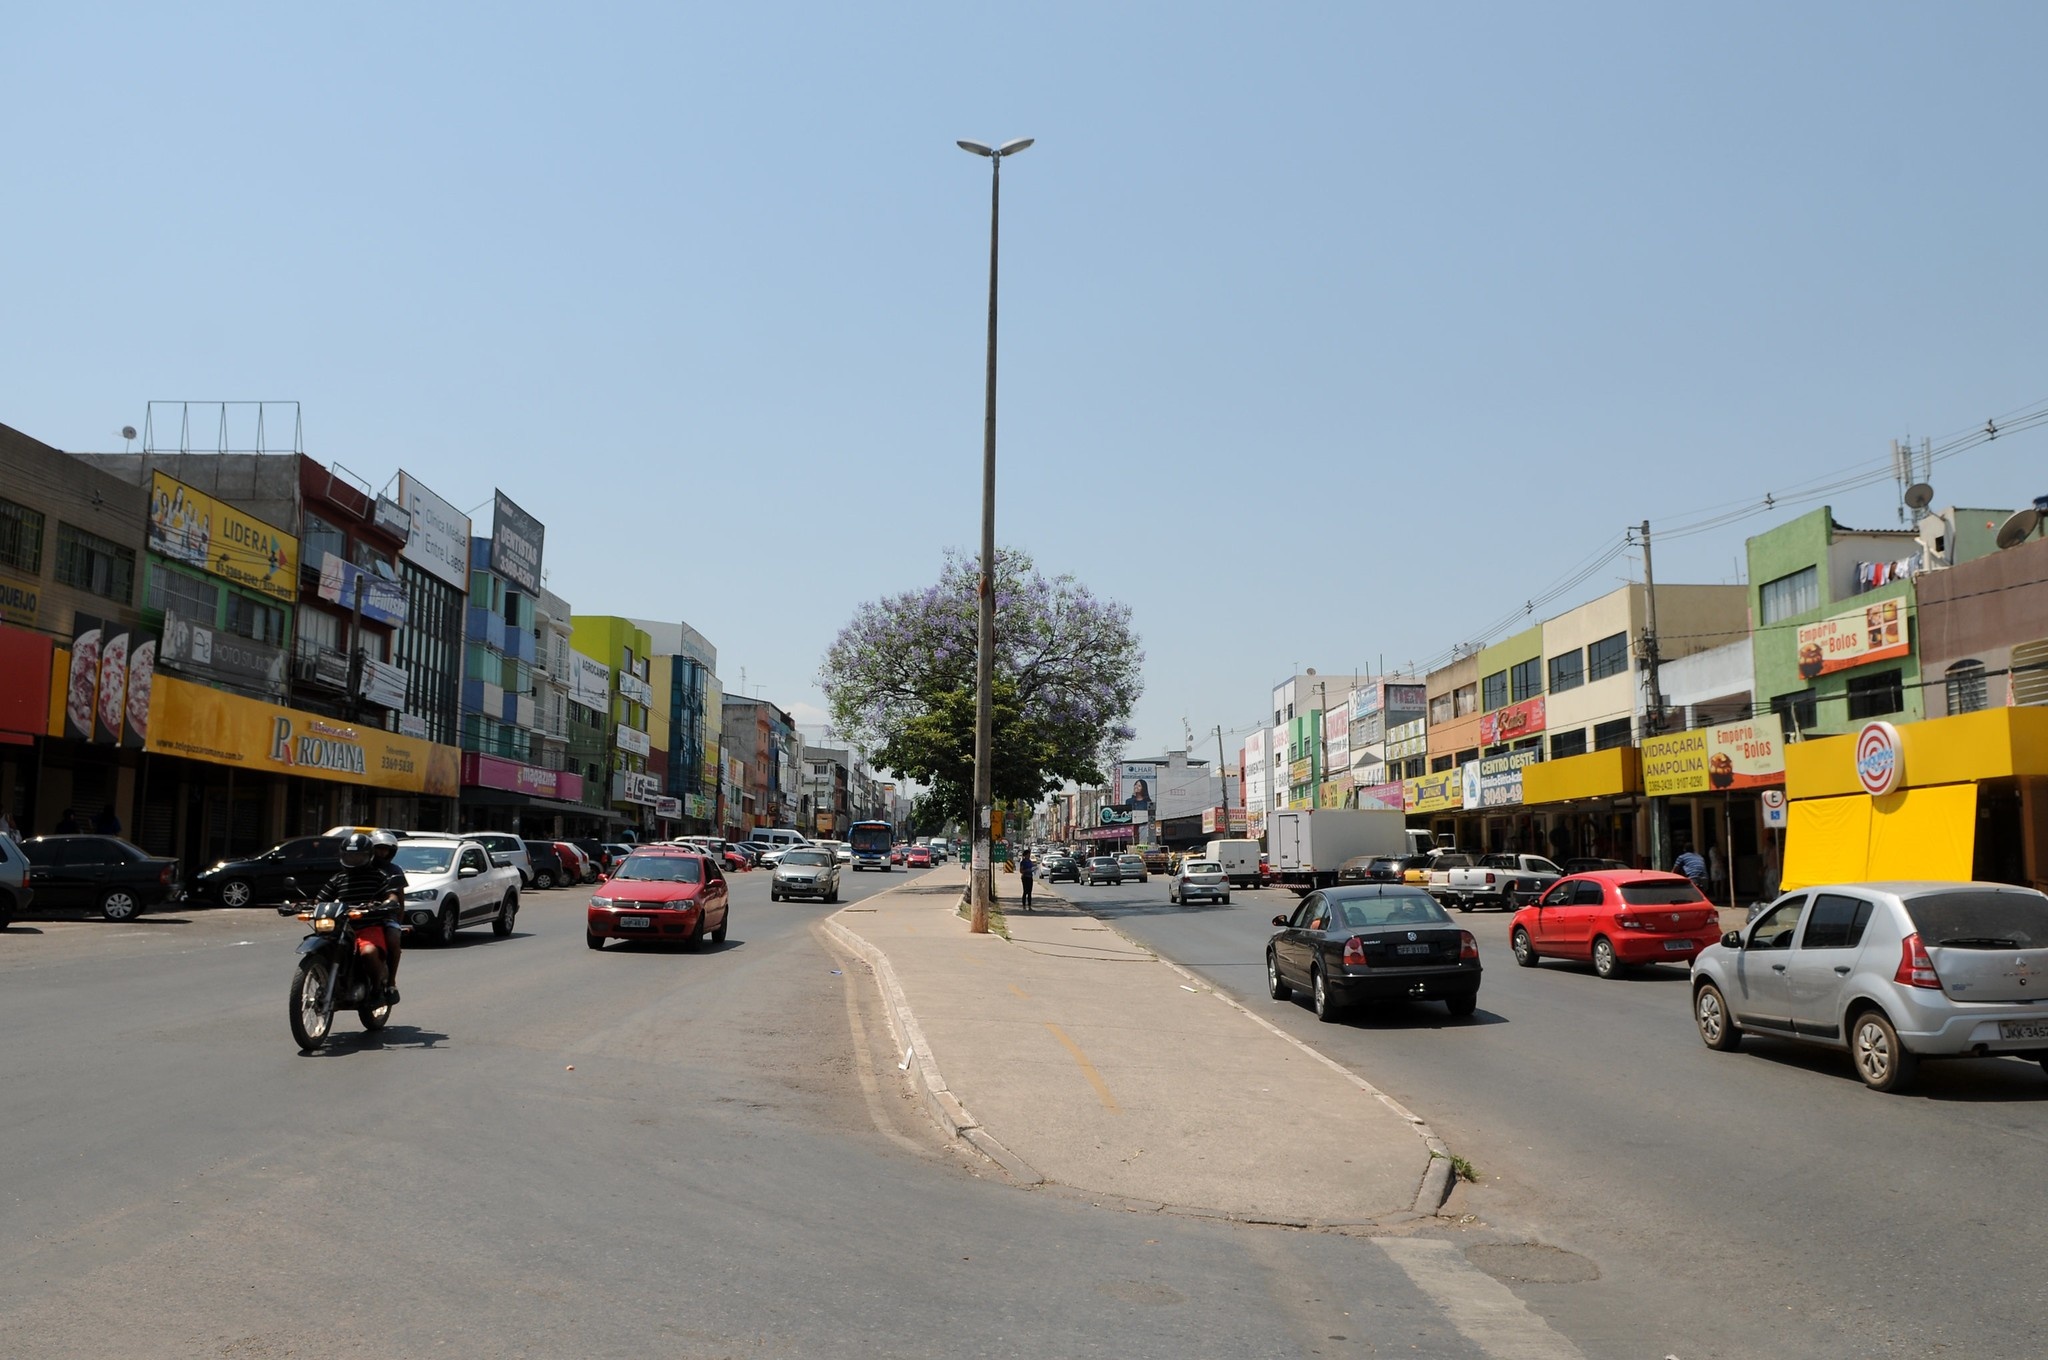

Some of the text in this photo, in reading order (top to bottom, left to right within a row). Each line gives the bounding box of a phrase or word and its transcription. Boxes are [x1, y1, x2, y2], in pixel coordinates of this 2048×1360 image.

[224, 517, 268, 555] LIDERA
[426, 509, 444, 533] Clínica
[446, 522, 466, 547] Médica
[426, 533, 465, 573] Entre Lagos
[501, 524, 537, 566] DENTISTAS
[1800, 621, 1837, 644] Empório
[1829, 633, 1857, 653] Bolos
[214, 643, 240, 664] PHOTO
[1717, 726, 1753, 744] Empório
[1642, 737, 1704, 759] VIDRAÇARIA
[1744, 741, 1772, 759] Bolos
[1482, 751, 1535, 775] CENTRO OESTE
[1646, 757, 1704, 777] ANAPOLINA
[523, 767, 556, 787] magazine
[1771, 792, 1778, 803] E
